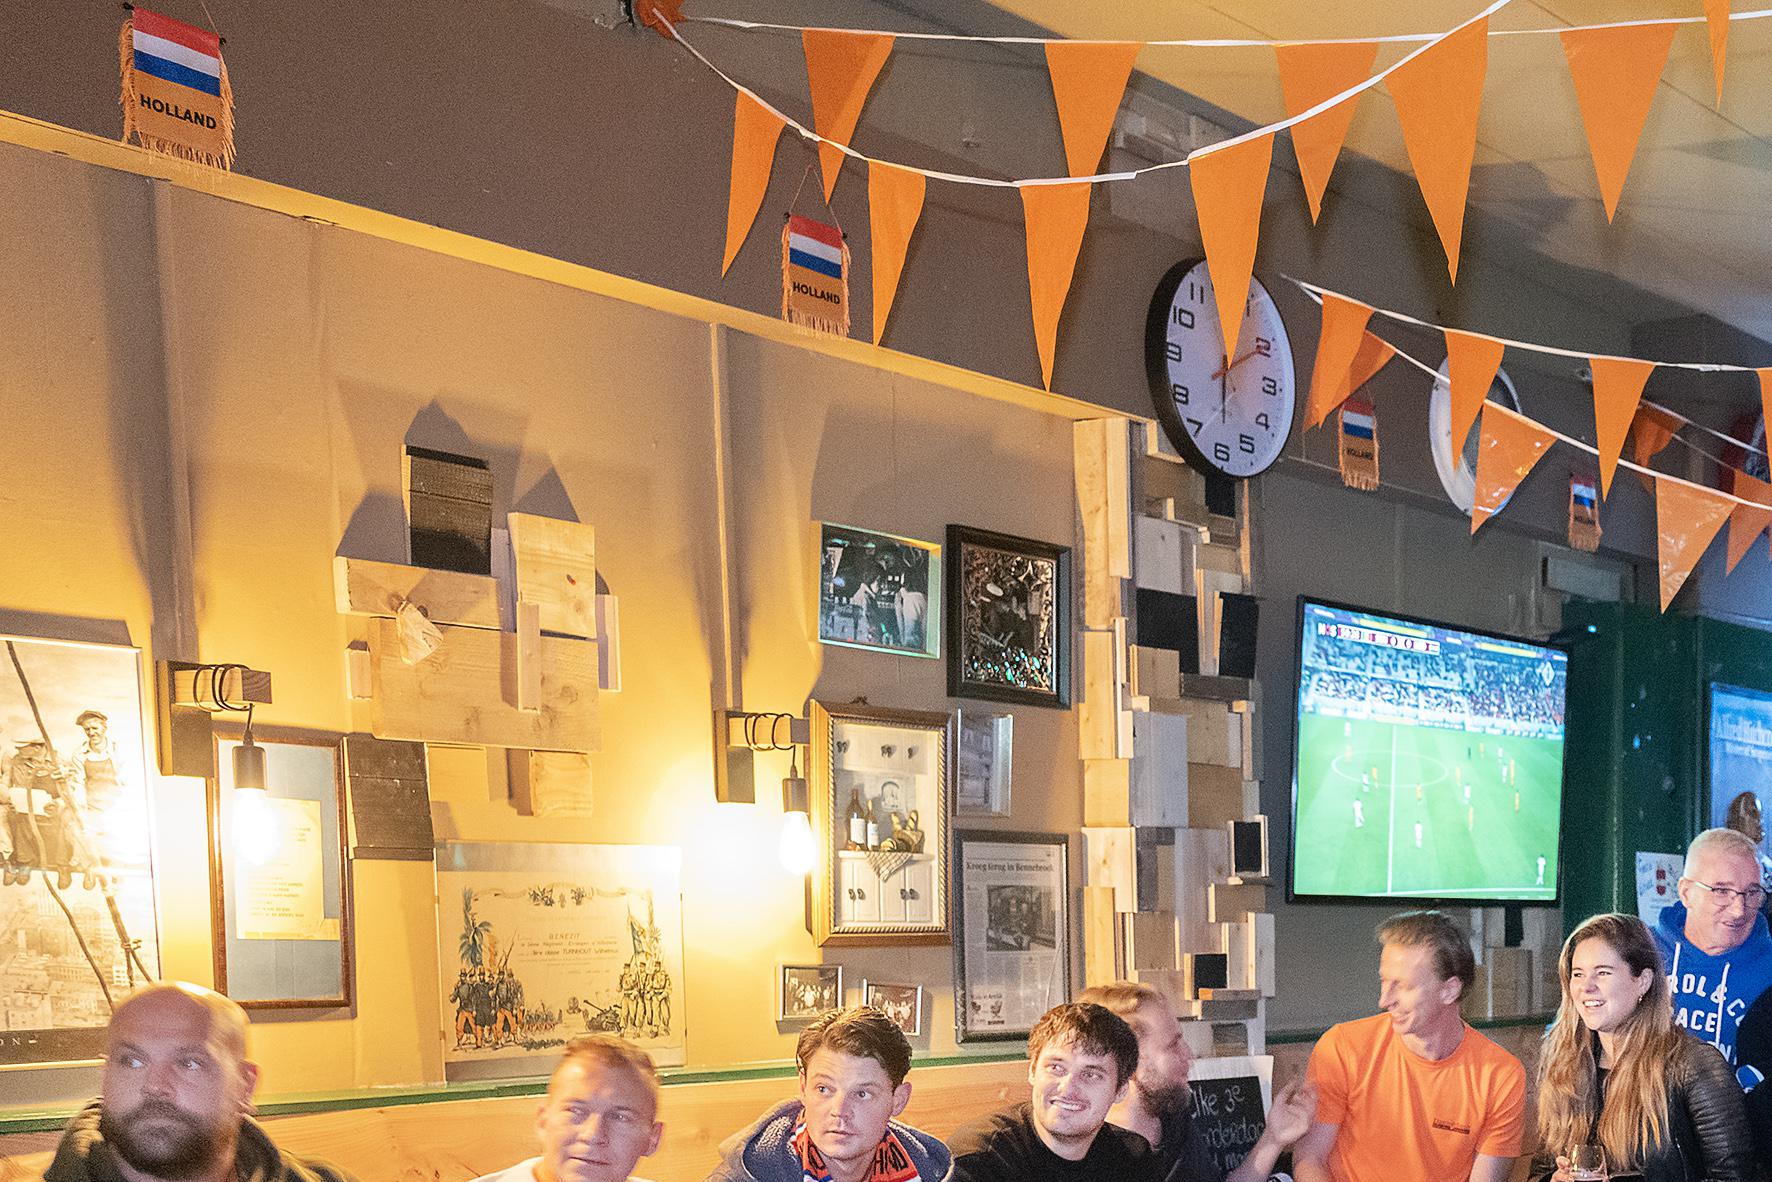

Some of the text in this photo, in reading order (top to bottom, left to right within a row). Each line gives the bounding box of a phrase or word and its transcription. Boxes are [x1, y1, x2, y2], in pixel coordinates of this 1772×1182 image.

[139, 94, 217, 129] HOLLAND
[792, 281, 840, 305] HOLLAND
[1190, 282, 1204, 304] 11
[1173, 306, 1195, 330] 10
[1167, 342, 1182, 362] 9
[1255, 336, 1271, 357] 2
[1173, 383, 1189, 405] 8
[1262, 375, 1277, 396] 3
[1186, 417, 1203, 437] 7
[1255, 413, 1270, 431] 4
[1214, 442, 1230, 463] 6
[1240, 433, 1255, 454] 5
[1674, 1007, 1718, 1033] ACE
